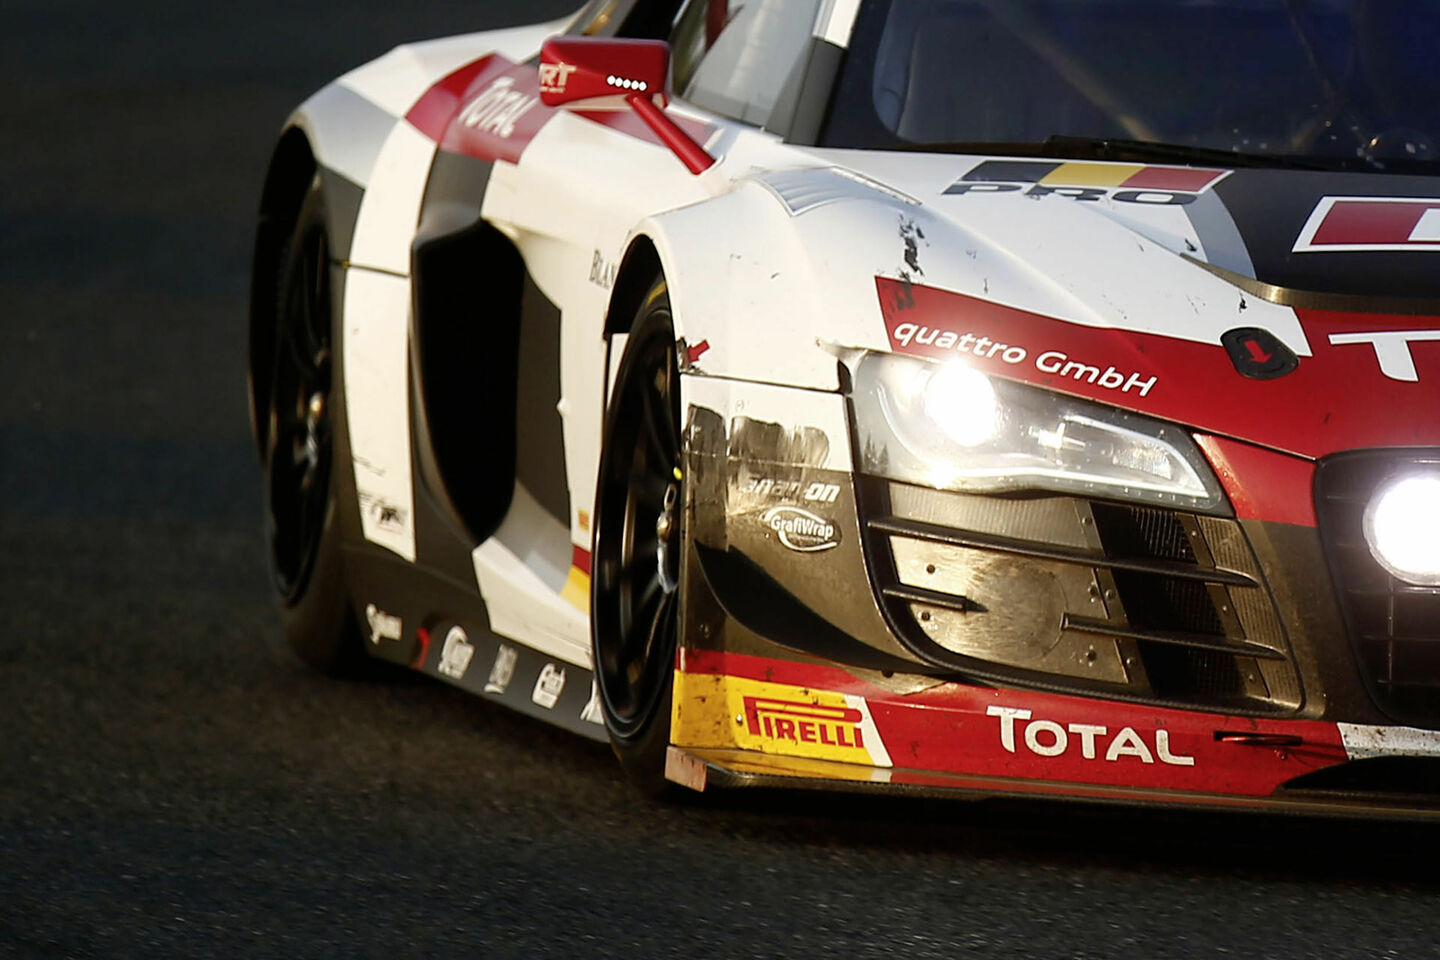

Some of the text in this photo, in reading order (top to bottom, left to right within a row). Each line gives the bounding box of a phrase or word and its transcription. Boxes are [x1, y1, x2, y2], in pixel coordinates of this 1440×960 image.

[941, 182, 1199, 206] PRO
[893, 321, 1158, 397] quattro GmbH
[770, 515, 834, 541] GrafiWrap
[743, 695, 863, 749] PIRELLI
[986, 705, 1195, 767] TOTAL
